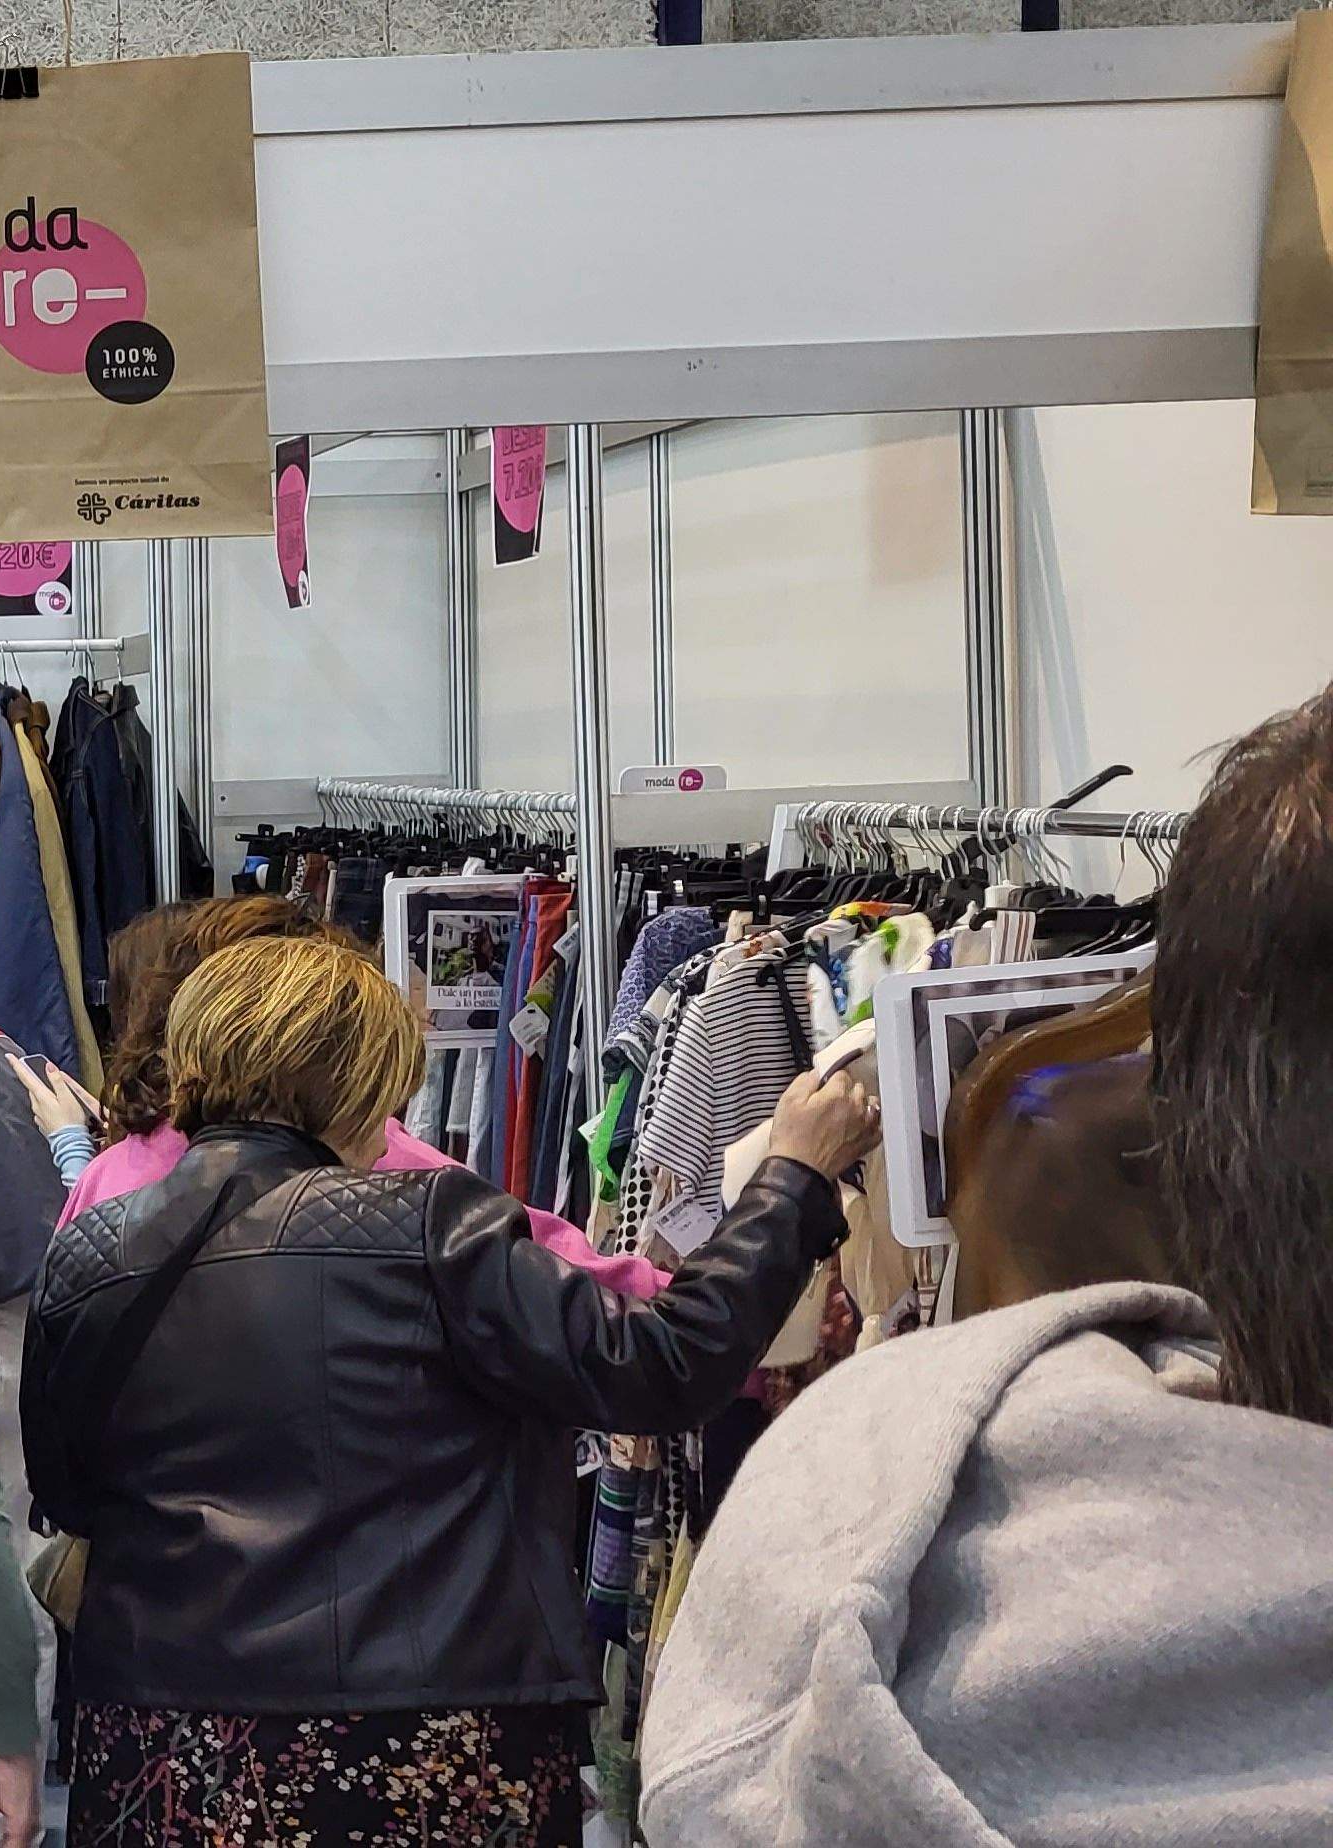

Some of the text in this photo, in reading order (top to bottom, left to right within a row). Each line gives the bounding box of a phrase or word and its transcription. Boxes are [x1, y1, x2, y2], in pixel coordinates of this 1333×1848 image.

[2, 267, 128, 328] re-
[102, 346, 158, 365] 100%
[102, 366, 159, 379] ETHICAL
[114, 493, 201, 510] Cáritas
[644, 776, 675, 788] moda
